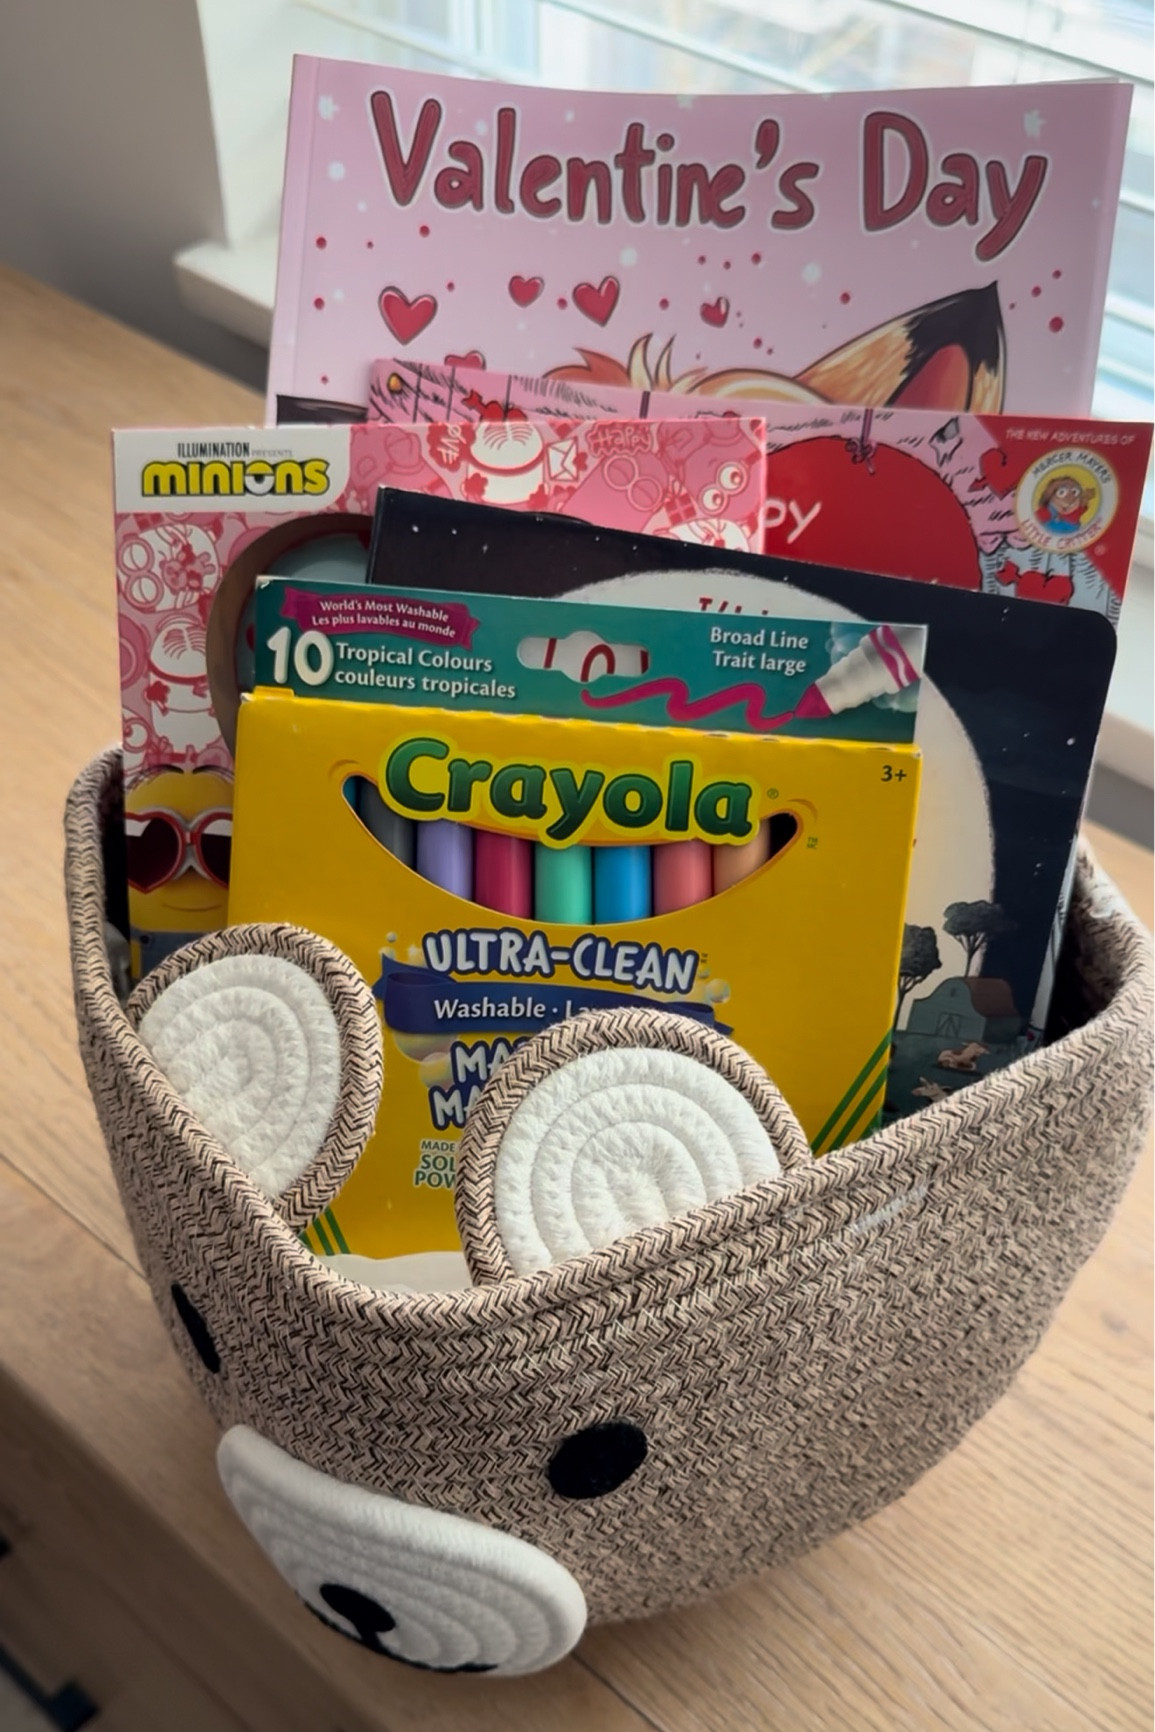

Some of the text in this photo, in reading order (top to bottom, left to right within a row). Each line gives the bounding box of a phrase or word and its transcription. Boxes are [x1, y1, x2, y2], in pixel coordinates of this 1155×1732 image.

[368, 89, 1050, 262] Valentine's Day
[177, 442, 250, 458] ILLUMINATION
[1005, 429, 1136, 446] THE NEW ADVENTURES OF
[319, 600, 450, 623] World's Most Washable
[311, 612, 456, 639] Les plus lavables au monde
[710, 626, 810, 650] Broad Line
[267, 626, 334, 687] 10
[336, 641, 493, 673] Tropical Colours
[712, 650, 807, 677] Trait large
[334, 669, 517, 699] couleurs tropicales
[881, 764, 907, 782] 3+
[384, 736, 754, 842] Crayola
[422, 929, 700, 994] ULTRA-CLEAN
[434, 997, 546, 1020] Washable
[421, 1140, 456, 1151] MADE
